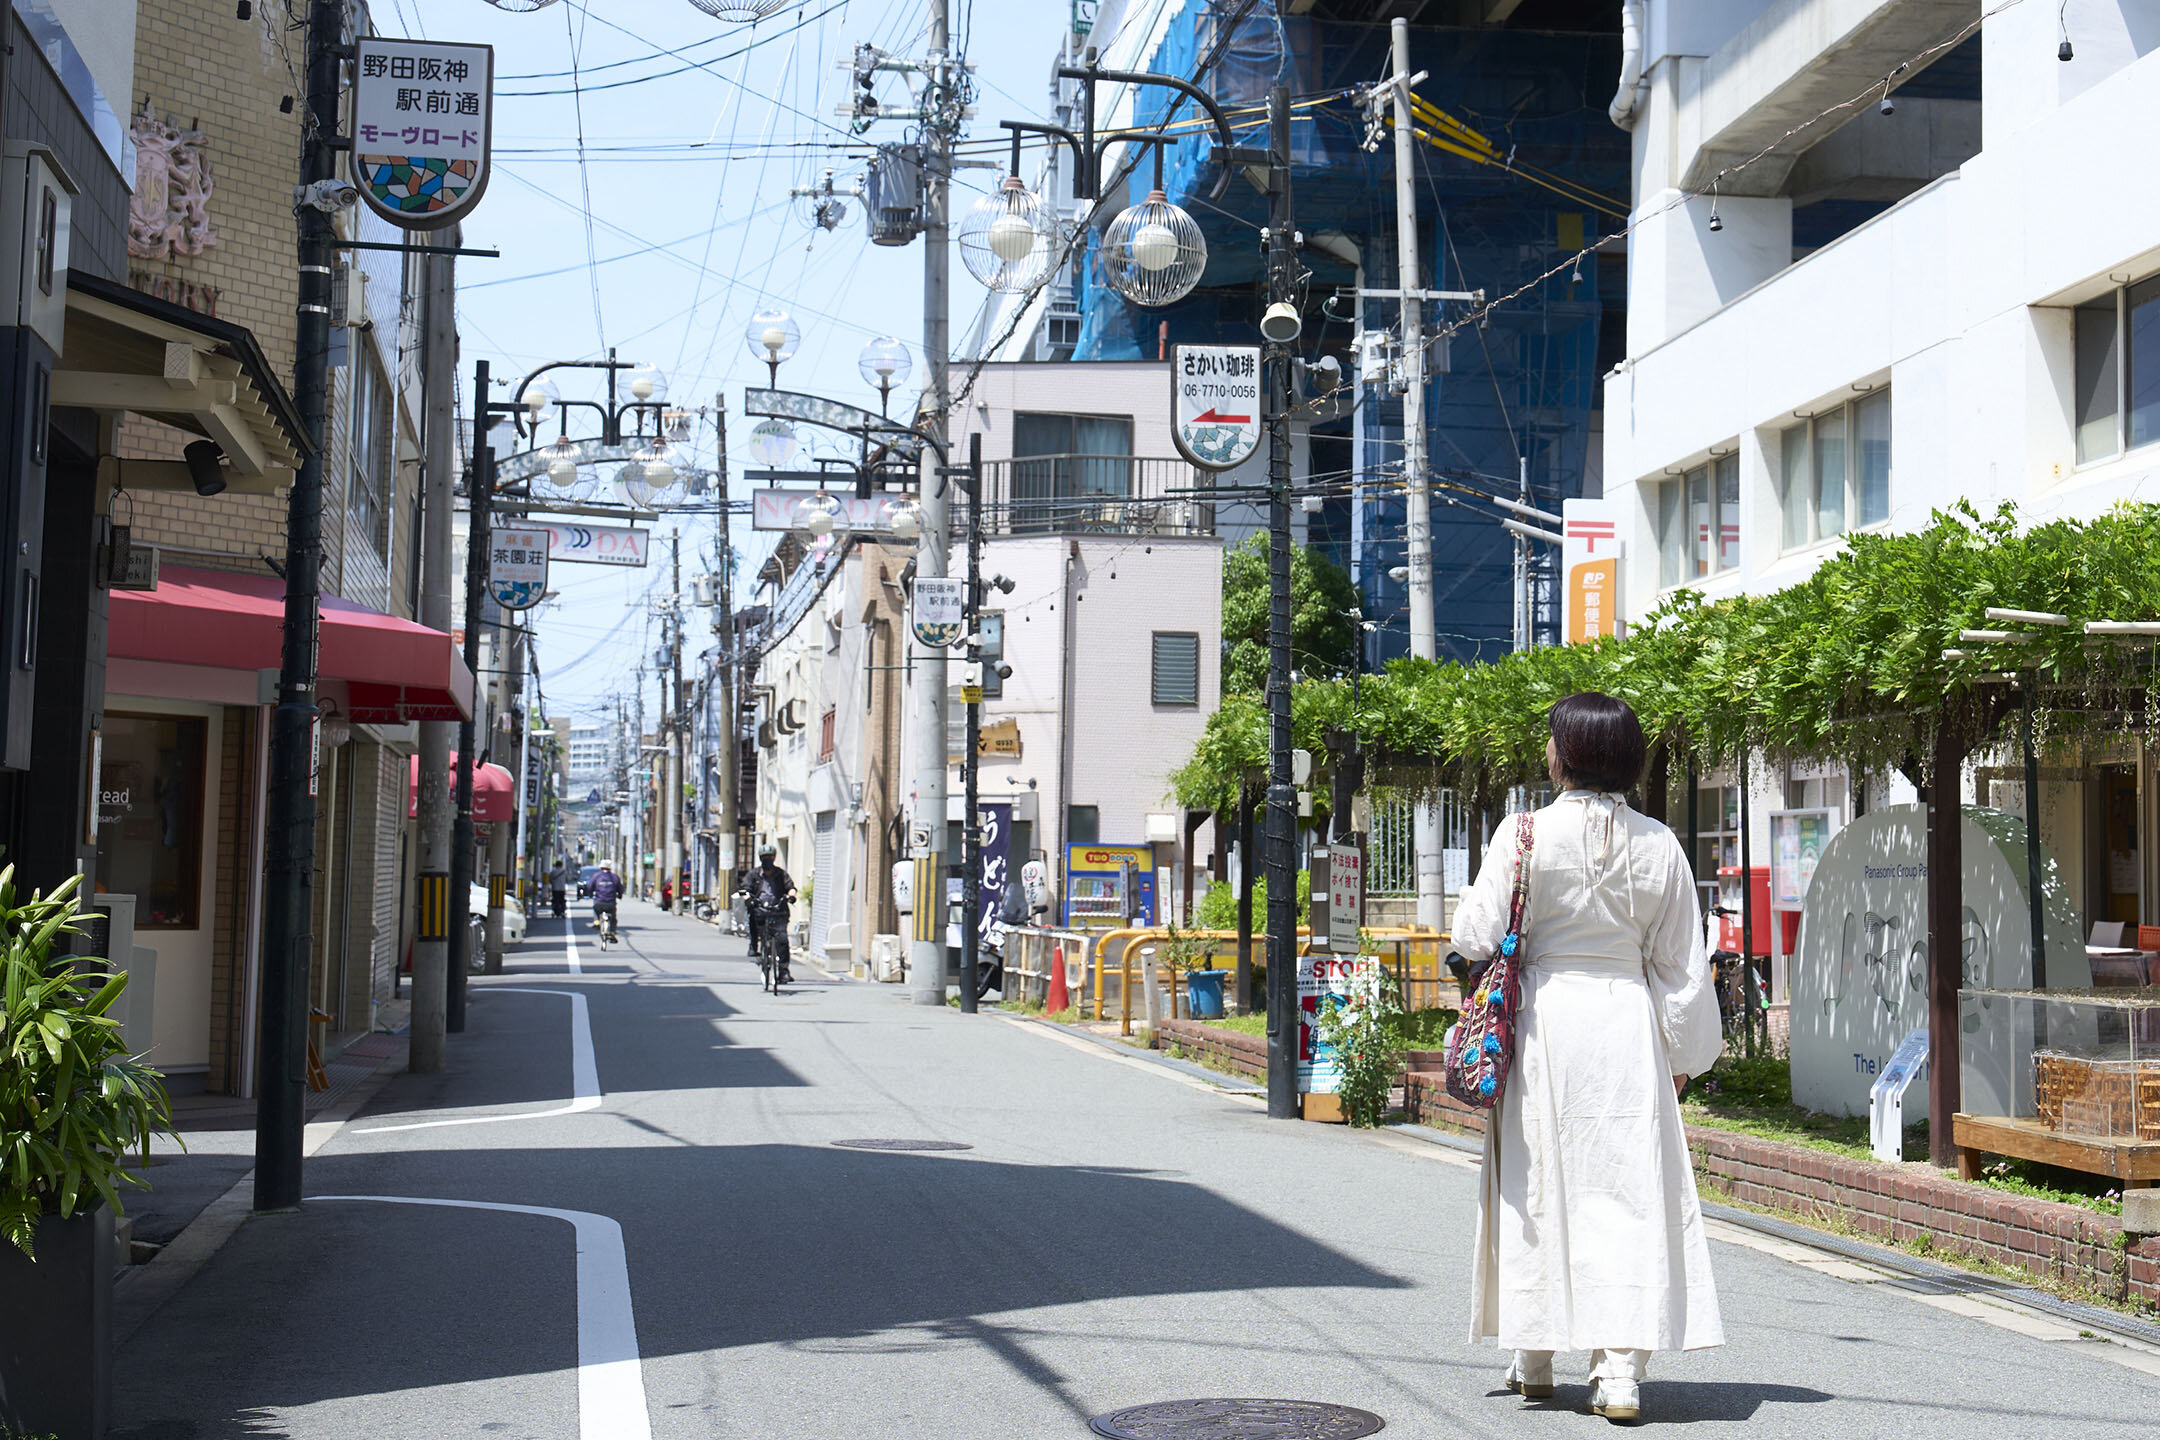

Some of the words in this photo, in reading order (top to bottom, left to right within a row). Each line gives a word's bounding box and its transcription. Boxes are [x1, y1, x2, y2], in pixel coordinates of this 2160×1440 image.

[363, 54, 468, 83] 野田阪神
[395, 88, 479, 116] 駅前通
[360, 124, 478, 148] モーヴロード
[1184, 353, 1255, 378] さかい珈琲
[1184, 383, 1256, 398] 06-7710-0056
[597, 531, 640, 556] DA
[493, 549, 544, 566] 茶園荘
[917, 584, 956, 593] 野田阪神
[929, 596, 960, 607] 駅前通
[1584, 592, 1600, 639] 郵便局
[1865, 865, 1895, 879] Panasonic
[1897, 864, 1917, 880] Group
[1919, 863, 1928, 877] Pa
[1853, 1053, 1876, 1075] The
